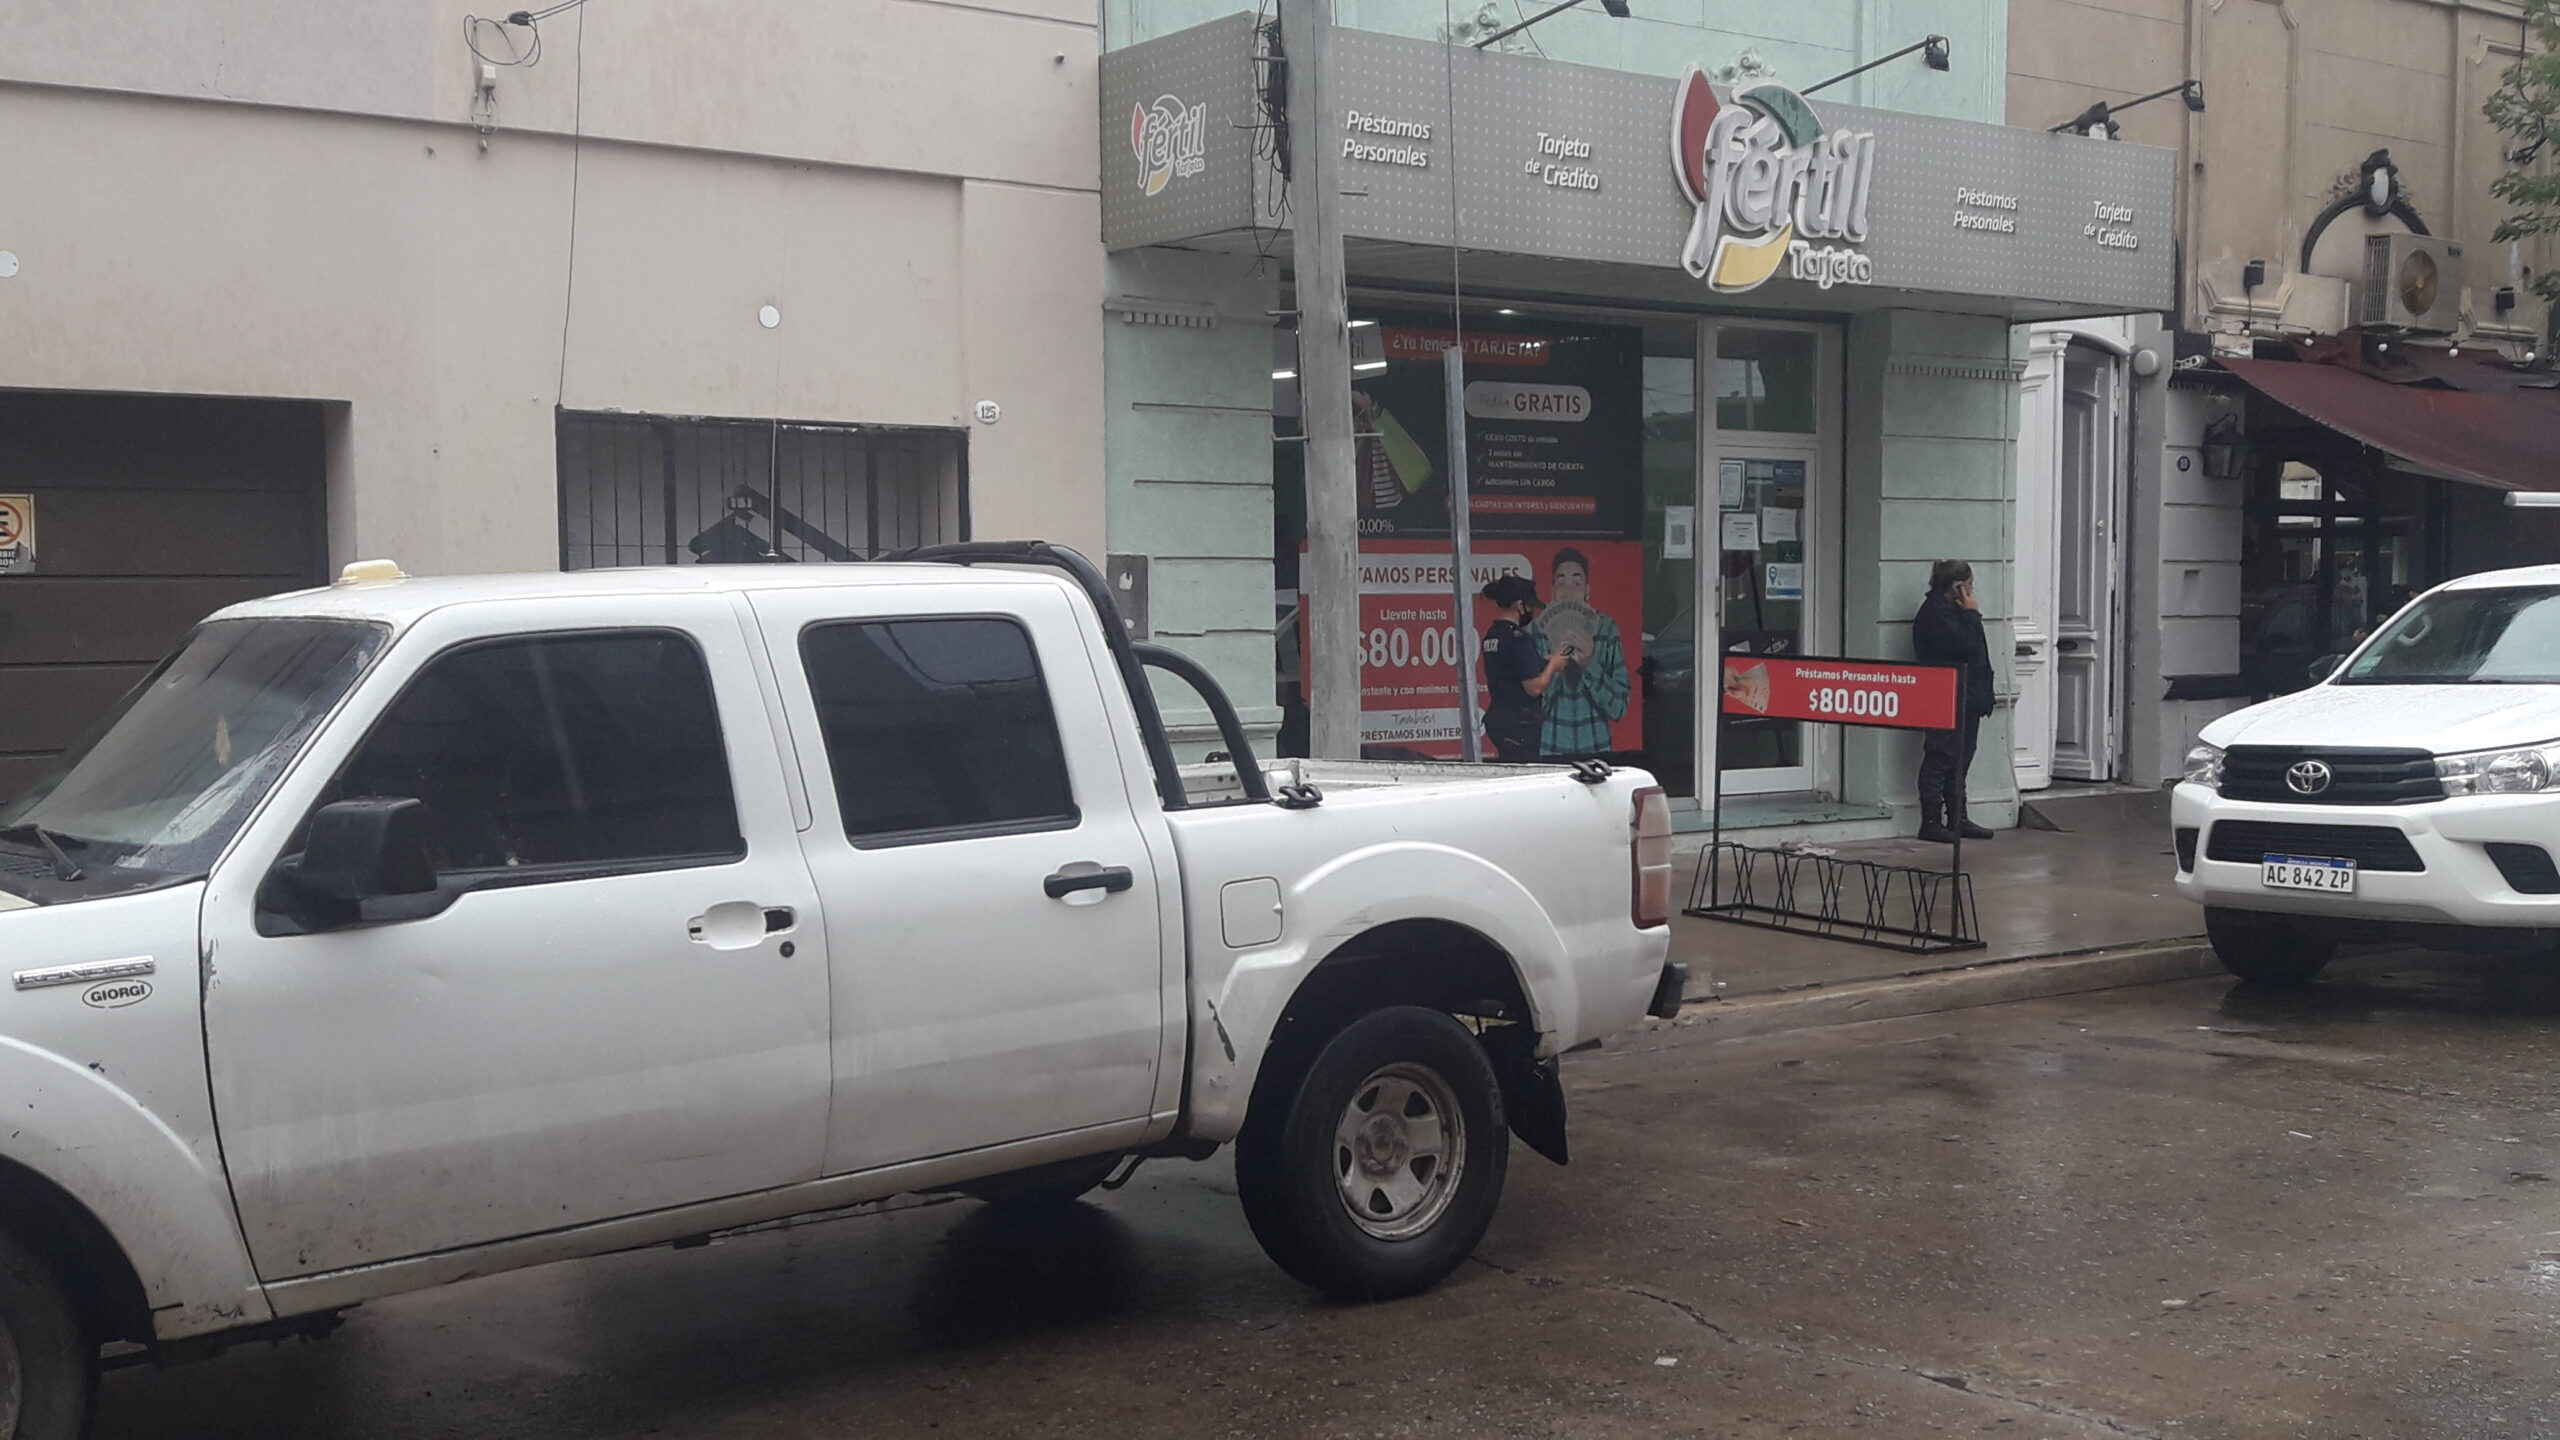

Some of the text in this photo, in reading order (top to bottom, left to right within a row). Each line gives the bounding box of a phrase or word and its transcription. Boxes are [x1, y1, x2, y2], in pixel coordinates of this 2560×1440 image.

[1346, 109, 1431, 141] Préstamos
[1342, 138, 1428, 168] Personales
[1536, 131, 1591, 161] Tarjeta
[1175, 157, 1205, 178] Tarjeta
[1524, 158, 1600, 191] de Crédito
[1956, 186, 2018, 211] Préstamos
[1953, 210, 2015, 234] Personales
[2093, 201, 2133, 225] Tarjeta
[2083, 222, 2139, 250] de Crédito
[1787, 238, 1873, 290] Tarjeta
[981, 405, 996, 419] 125
[1514, 393, 1581, 414] GRATIS
[1380, 608, 1447, 622] Llevate hasta
[1795, 667, 1917, 685] Préstamos Personales hasta
[1808, 687, 1899, 718] $80.000
[1415, 729, 1431, 738] SIN
[2266, 865, 2350, 889] AC 842 ZP
[90, 984, 146, 1003] GIORGI
